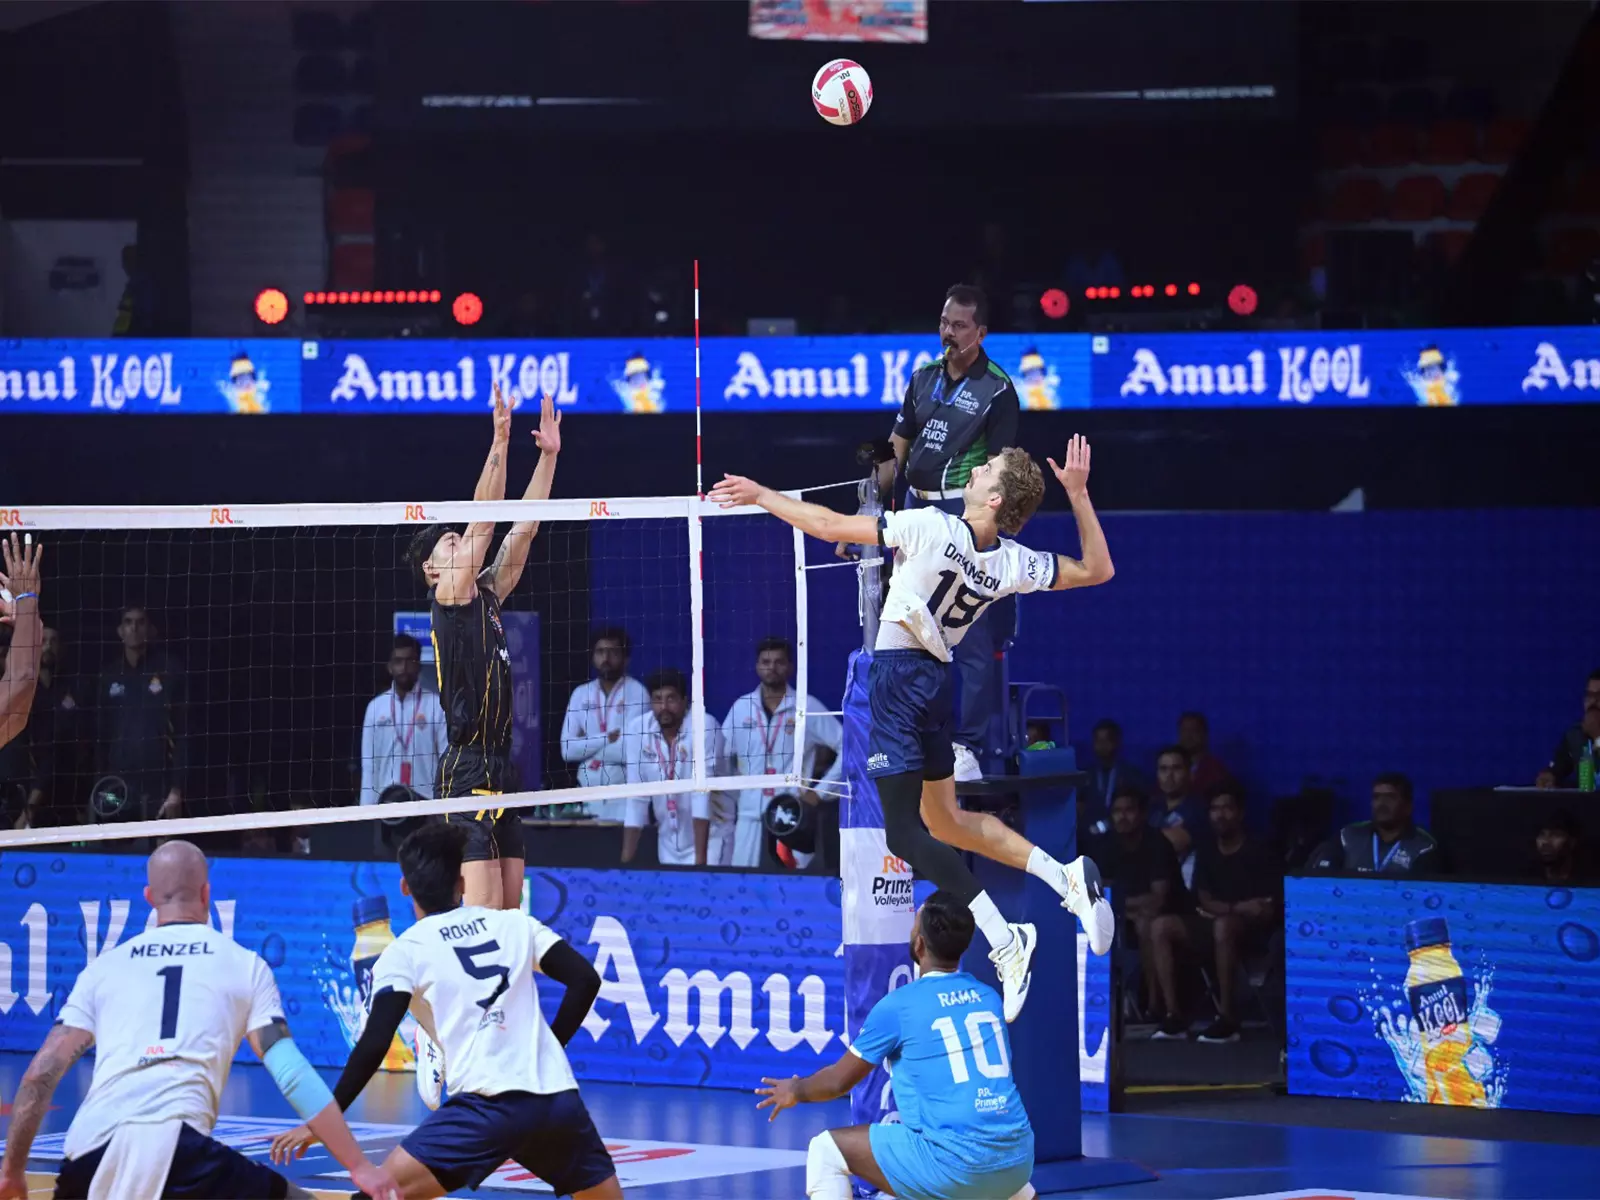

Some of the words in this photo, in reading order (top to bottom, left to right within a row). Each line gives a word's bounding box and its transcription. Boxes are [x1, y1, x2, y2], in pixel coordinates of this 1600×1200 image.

[90, 353, 181, 409] KOOL
[331, 353, 476, 403] Amul
[488, 352, 578, 410] KOOL
[724, 352, 870, 400] Amul
[1120, 348, 1267, 396] Amul
[1278, 345, 1370, 403] KOOL
[926, 569, 994, 629] 18
[130, 941, 214, 959] MENZEL
[438, 917, 488, 942] ROHIT
[156, 964, 183, 1040] 1
[452, 939, 511, 1010] 5
[937, 989, 982, 1008] RAMA
[1420, 984, 1448, 1009] Amul
[1418, 992, 1466, 1038] KOOL
[931, 1011, 1010, 1085] 10
